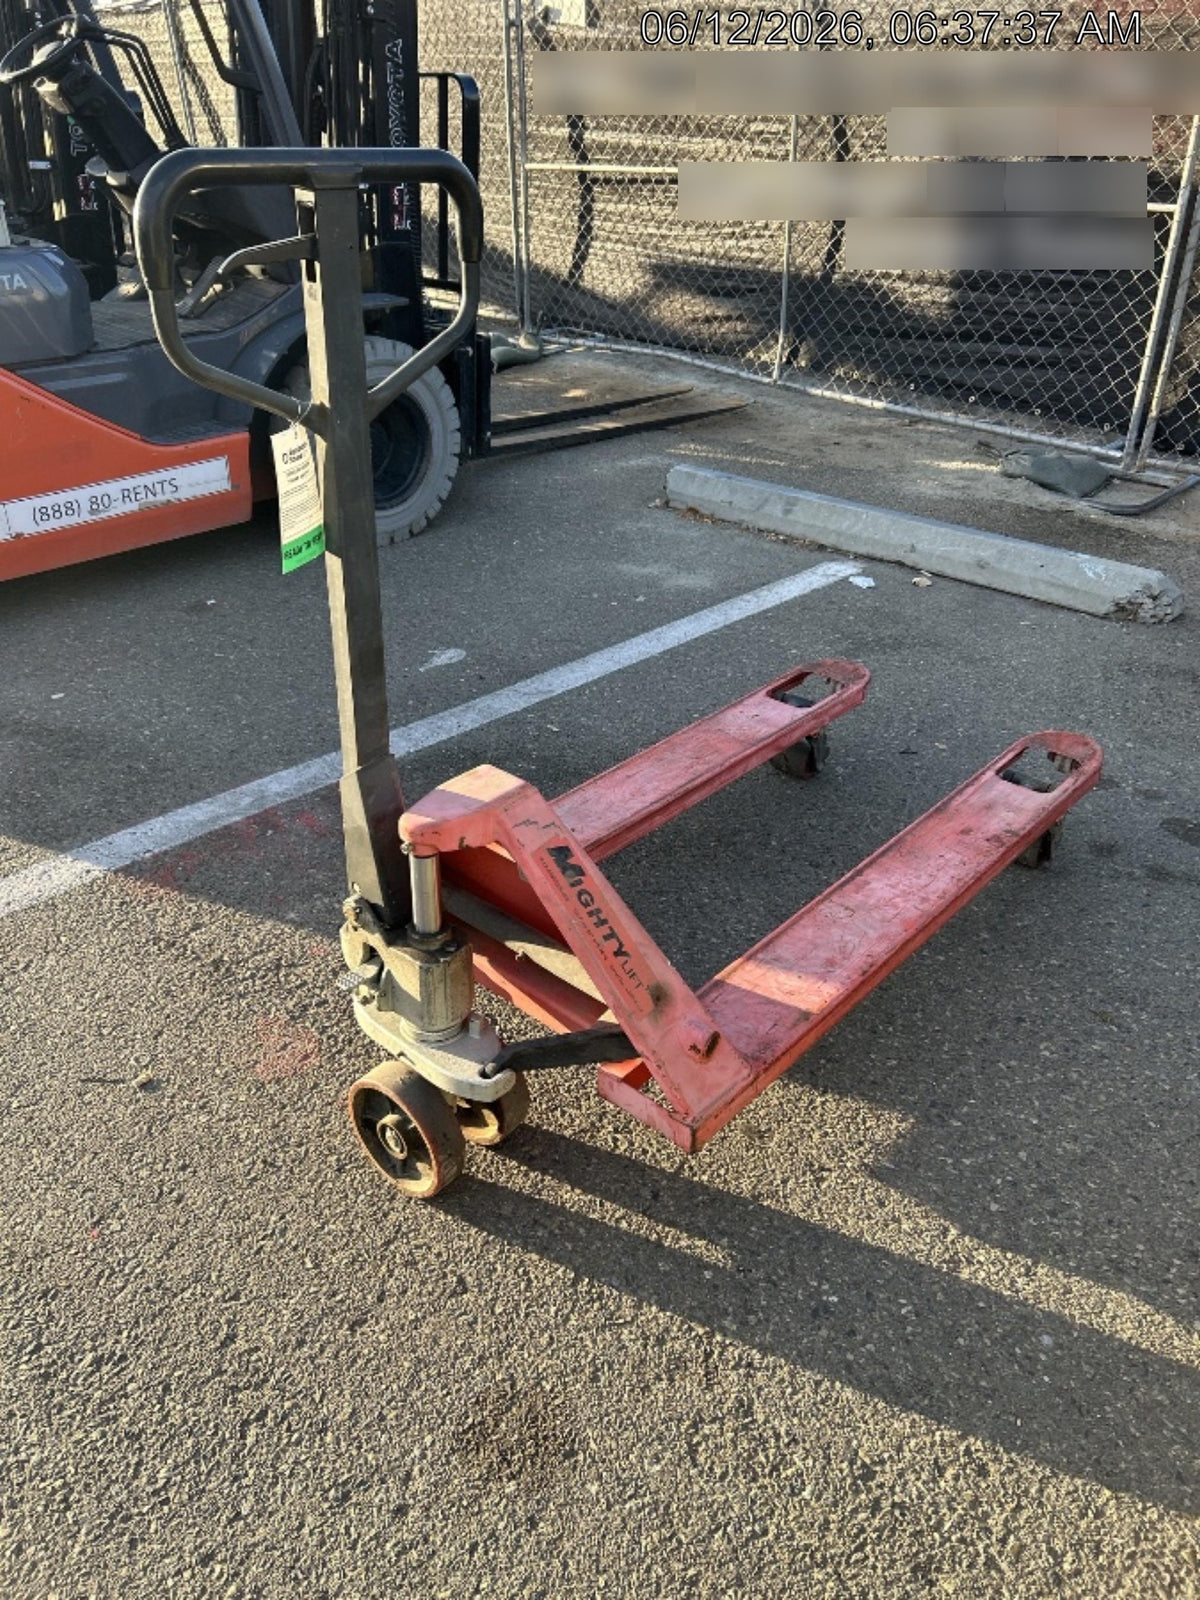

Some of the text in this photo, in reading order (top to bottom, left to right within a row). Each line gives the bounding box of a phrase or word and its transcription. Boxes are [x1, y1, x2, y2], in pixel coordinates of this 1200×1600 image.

[385, 38, 406, 148] OYOTA
[32, 478, 179, 526] (888) 80-RENTS
